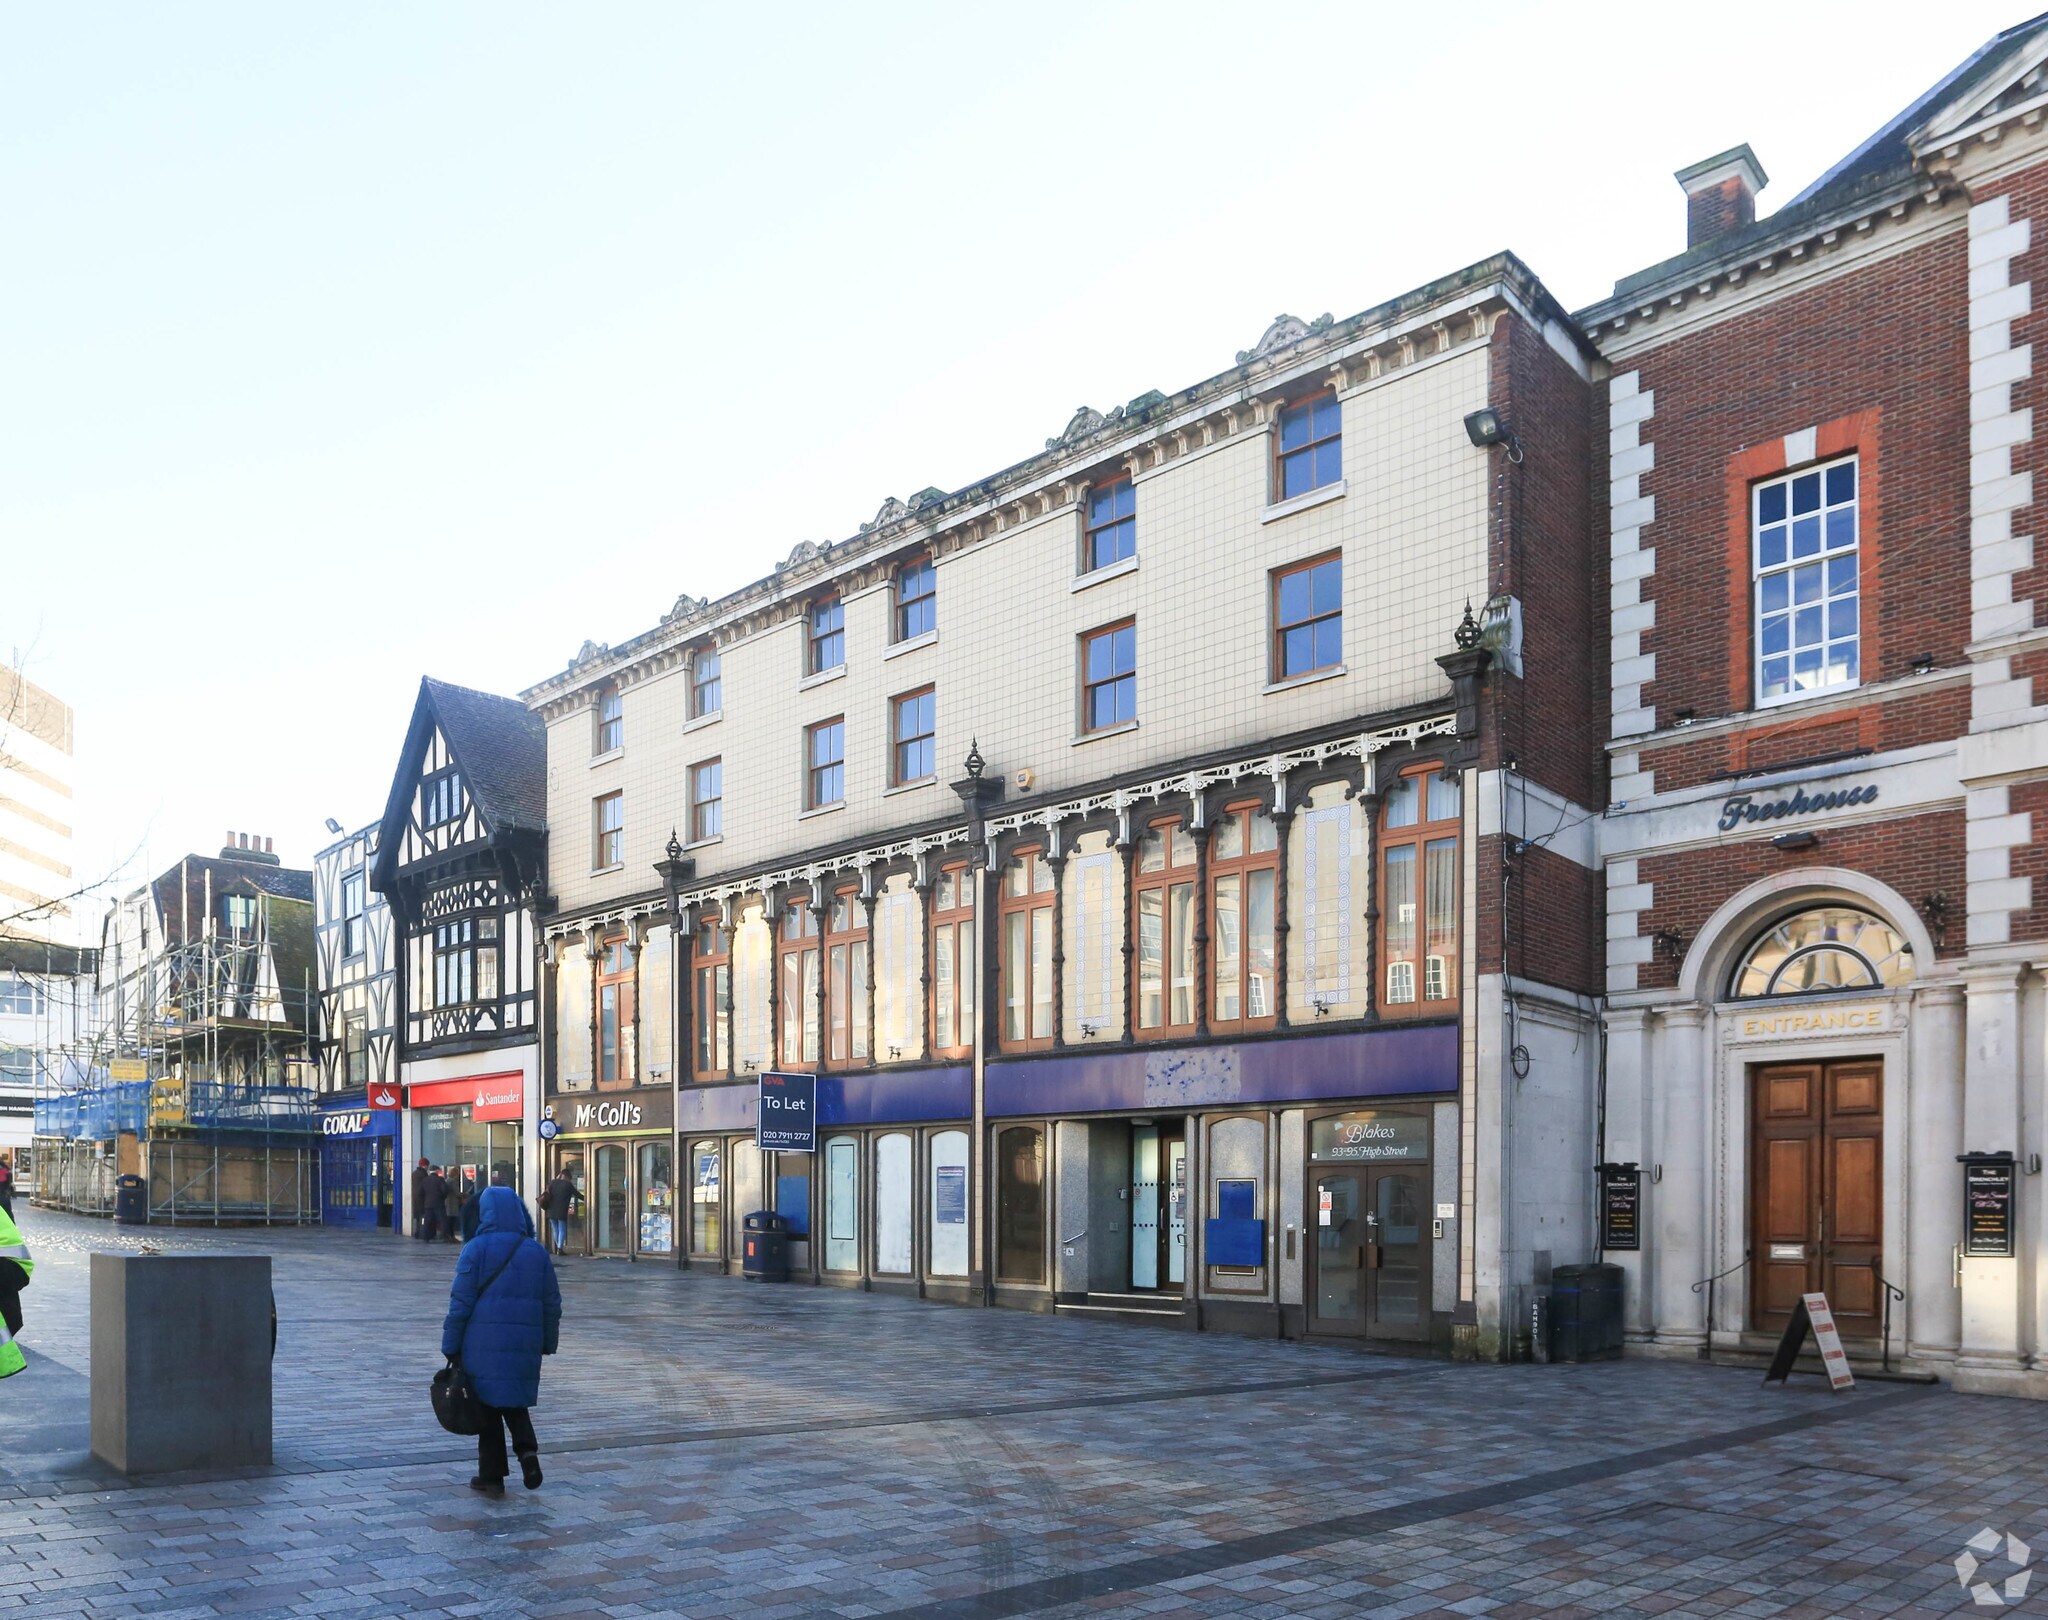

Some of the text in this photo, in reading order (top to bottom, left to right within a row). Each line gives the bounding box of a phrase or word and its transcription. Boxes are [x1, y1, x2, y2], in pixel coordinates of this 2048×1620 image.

[1717, 784, 1879, 831] Freehouse
[1743, 1008, 1883, 1036] ENTRANCE
[485, 1092, 520, 1106] Santander
[764, 1096, 805, 1110] To Let
[322, 1113, 363, 1136] CORAL
[574, 1100, 642, 1128] McColl's
[763, 1131, 811, 1140] 020 7911 2727
[1344, 1123, 1396, 1144] Blakes
[1358, 1146, 1382, 1159] High
[1382, 1145, 1409, 1156] Street
